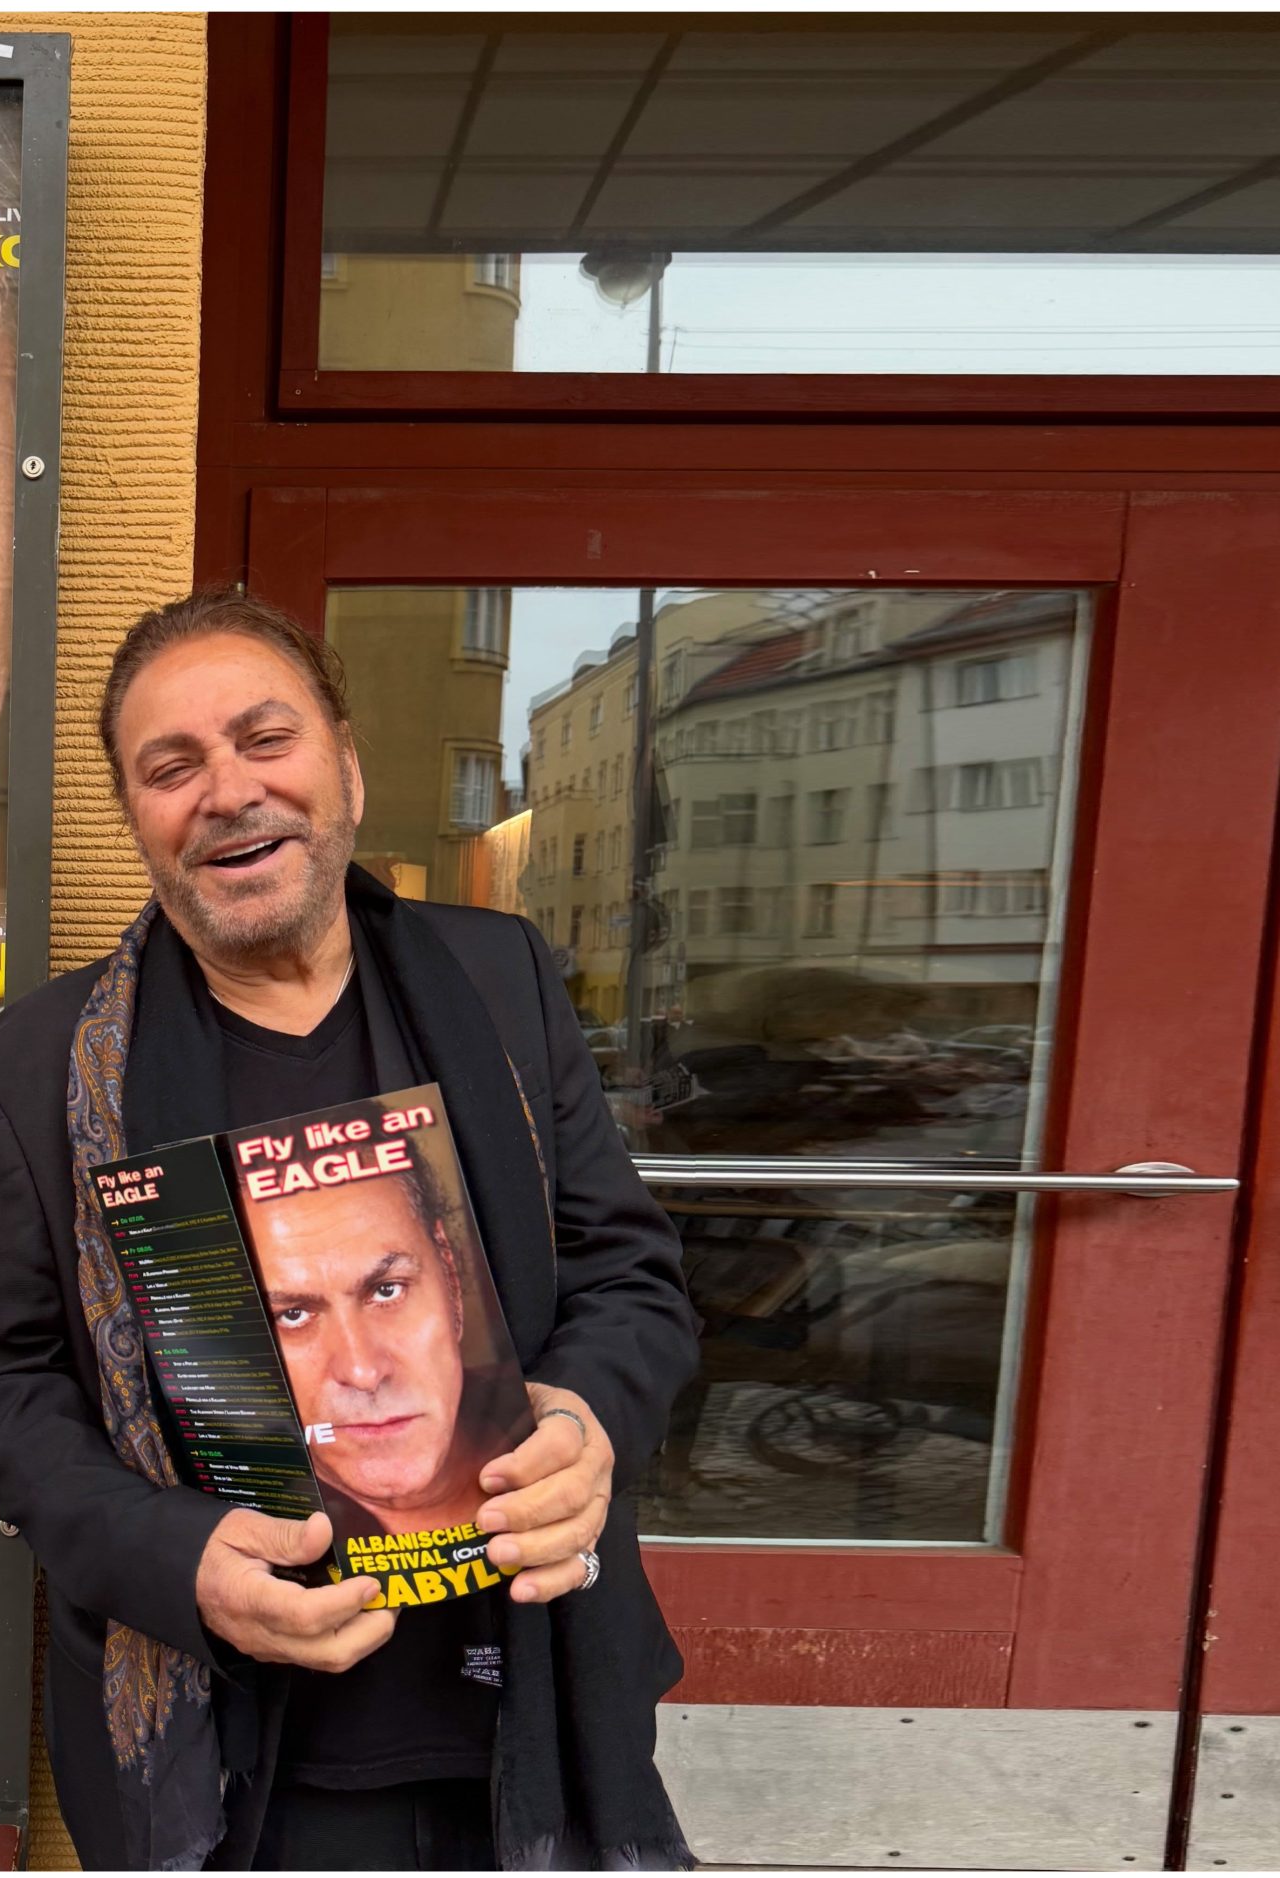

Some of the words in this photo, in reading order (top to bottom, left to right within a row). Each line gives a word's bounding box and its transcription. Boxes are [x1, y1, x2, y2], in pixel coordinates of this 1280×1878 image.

[237, 1134, 294, 1165] Fly
[304, 1120, 370, 1150] like
[382, 1105, 434, 1133] an
[97, 1174, 116, 1189] Fly
[117, 1170, 142, 1185] like
[144, 1165, 164, 1180] an
[245, 1140, 413, 1202] EAGLE
[102, 1183, 160, 1208] EAGLE
[349, 1548, 448, 1574] FESTIVAL
